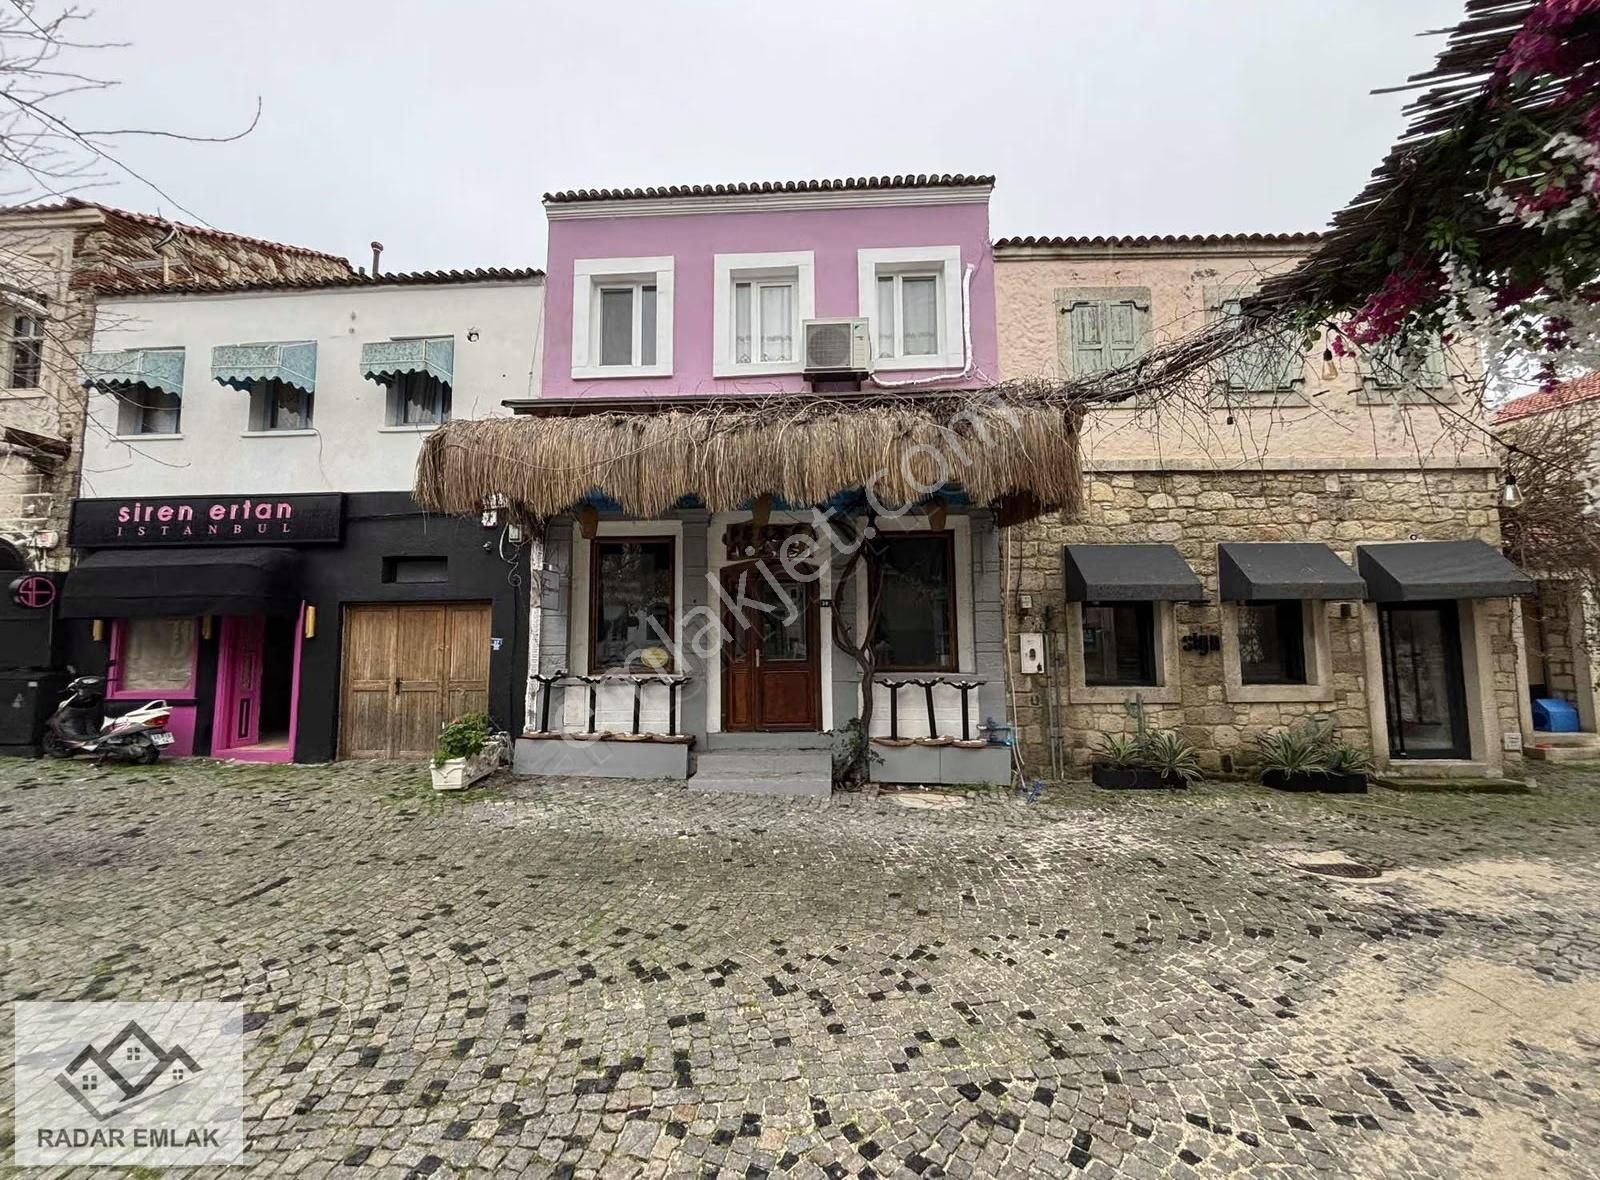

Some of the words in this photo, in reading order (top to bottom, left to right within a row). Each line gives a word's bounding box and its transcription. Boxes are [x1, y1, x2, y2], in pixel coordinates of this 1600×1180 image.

[118, 502, 193, 523] siren
[209, 499, 292, 521] ertan
[117, 524, 291, 536] ISTANBUL
